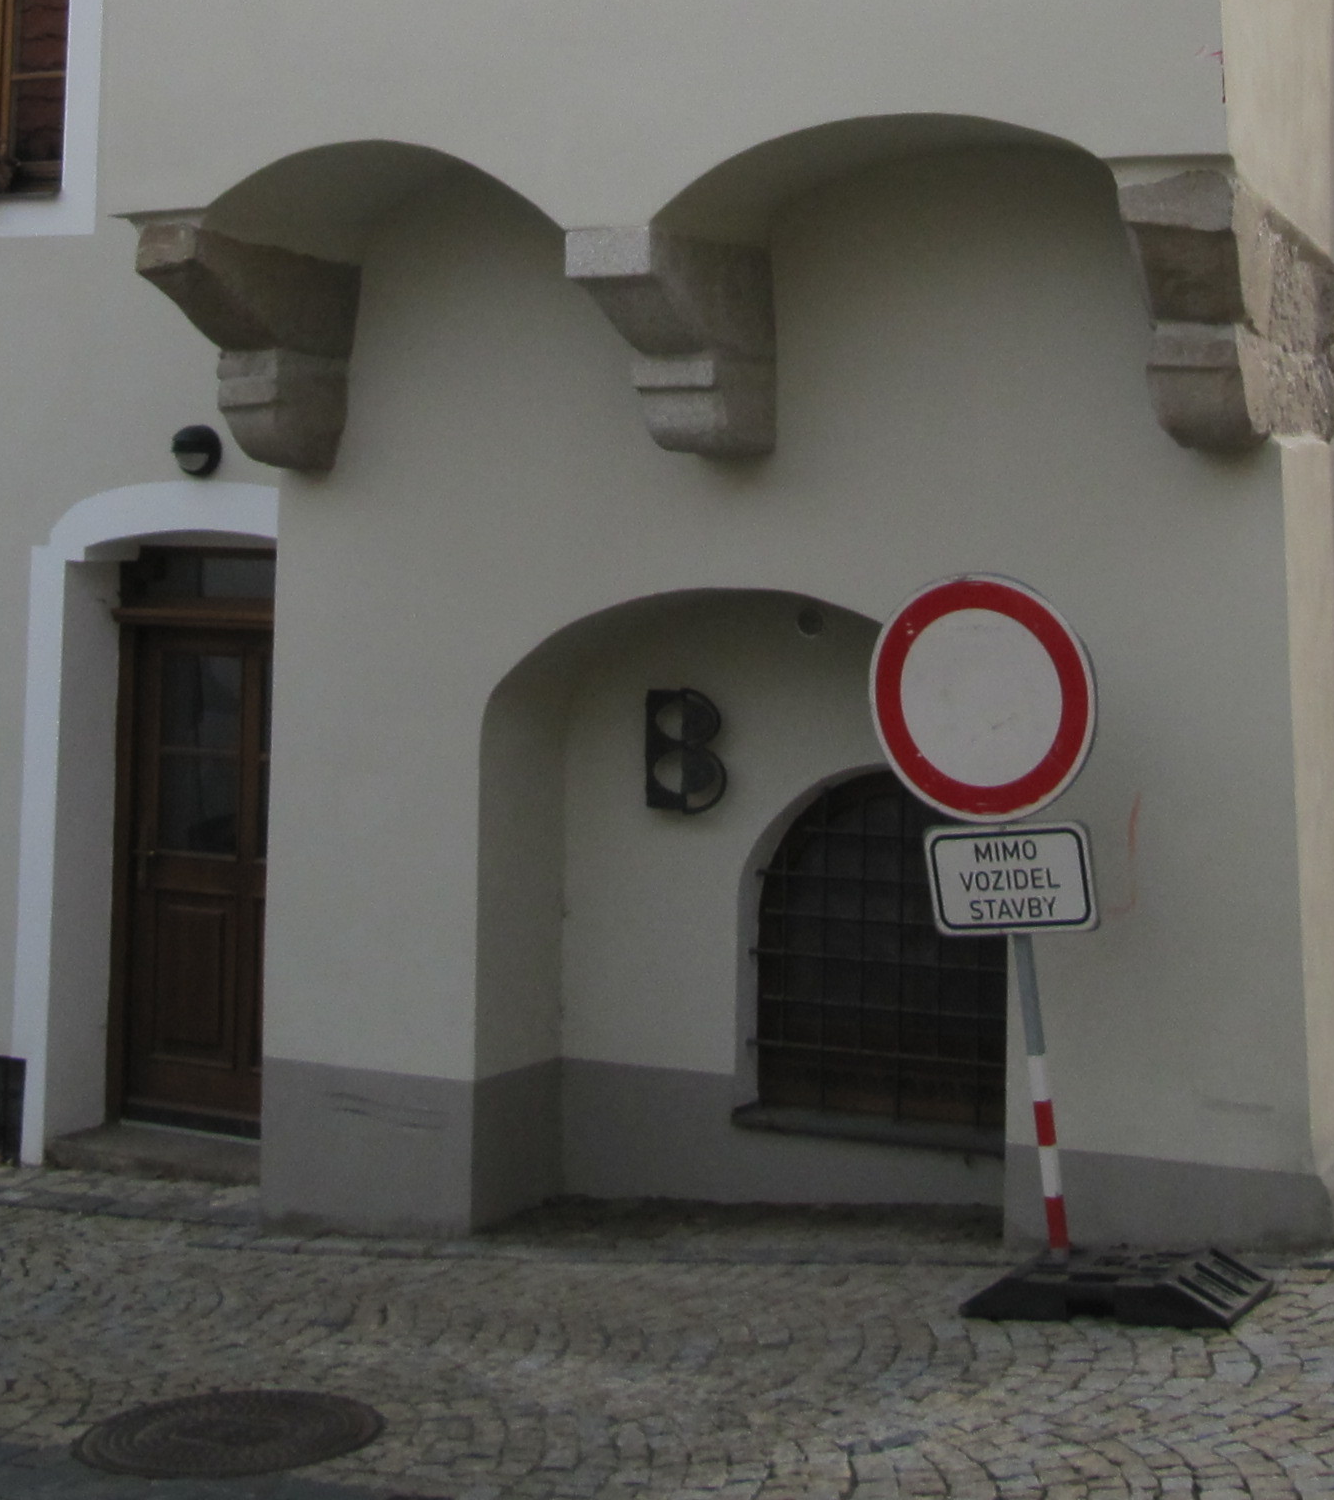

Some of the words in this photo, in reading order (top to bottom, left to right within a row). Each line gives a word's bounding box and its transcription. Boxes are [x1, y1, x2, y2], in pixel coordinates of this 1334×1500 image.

[974, 840, 1038, 863] MIMO
[959, 867, 1061, 892] VOZIDEL
[969, 896, 1057, 920] STAVBY
